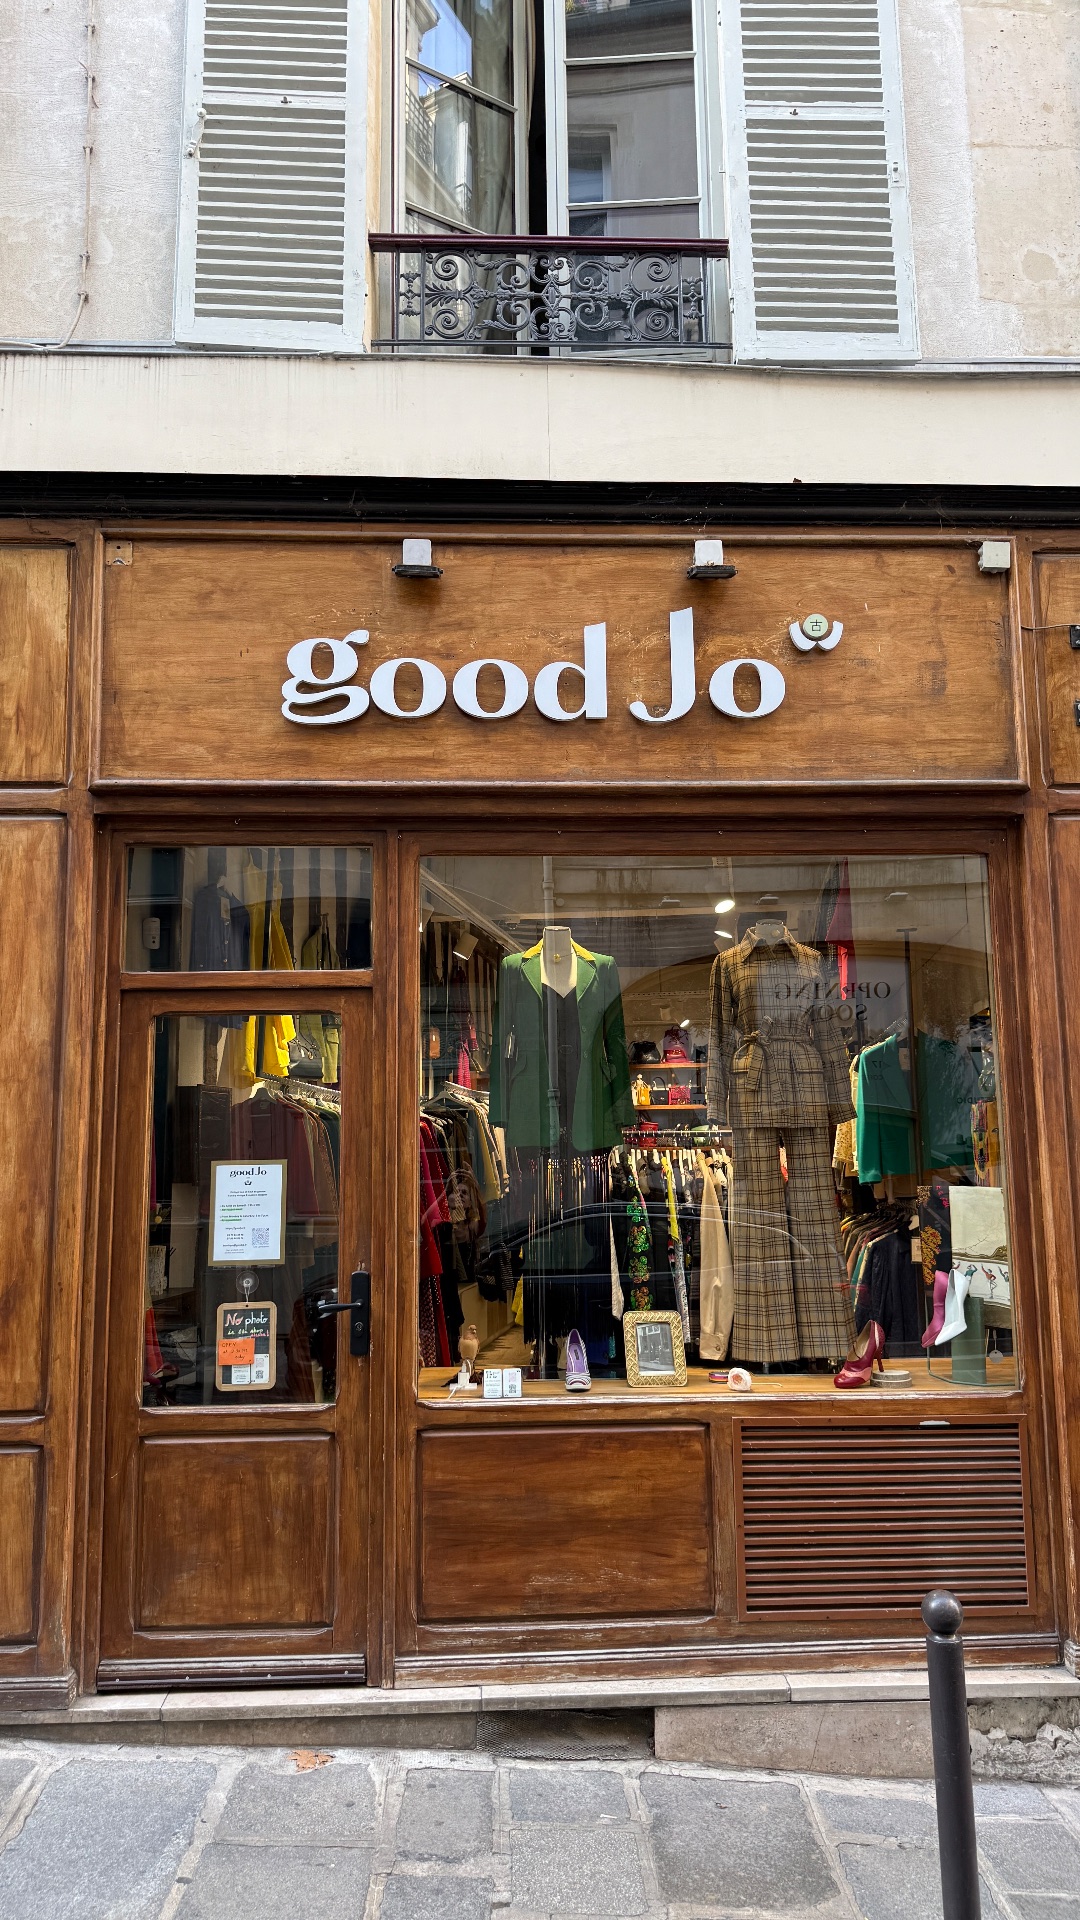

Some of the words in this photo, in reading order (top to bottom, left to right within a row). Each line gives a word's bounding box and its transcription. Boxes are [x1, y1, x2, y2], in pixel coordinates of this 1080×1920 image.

[281, 621, 608, 725] good
[629, 606, 786, 724] Jo
[230, 1168, 254, 1177] good
[255, 1166, 267, 1175] Jo
[225, 1313, 244, 1326] No
[245, 1312, 268, 1330] photo
